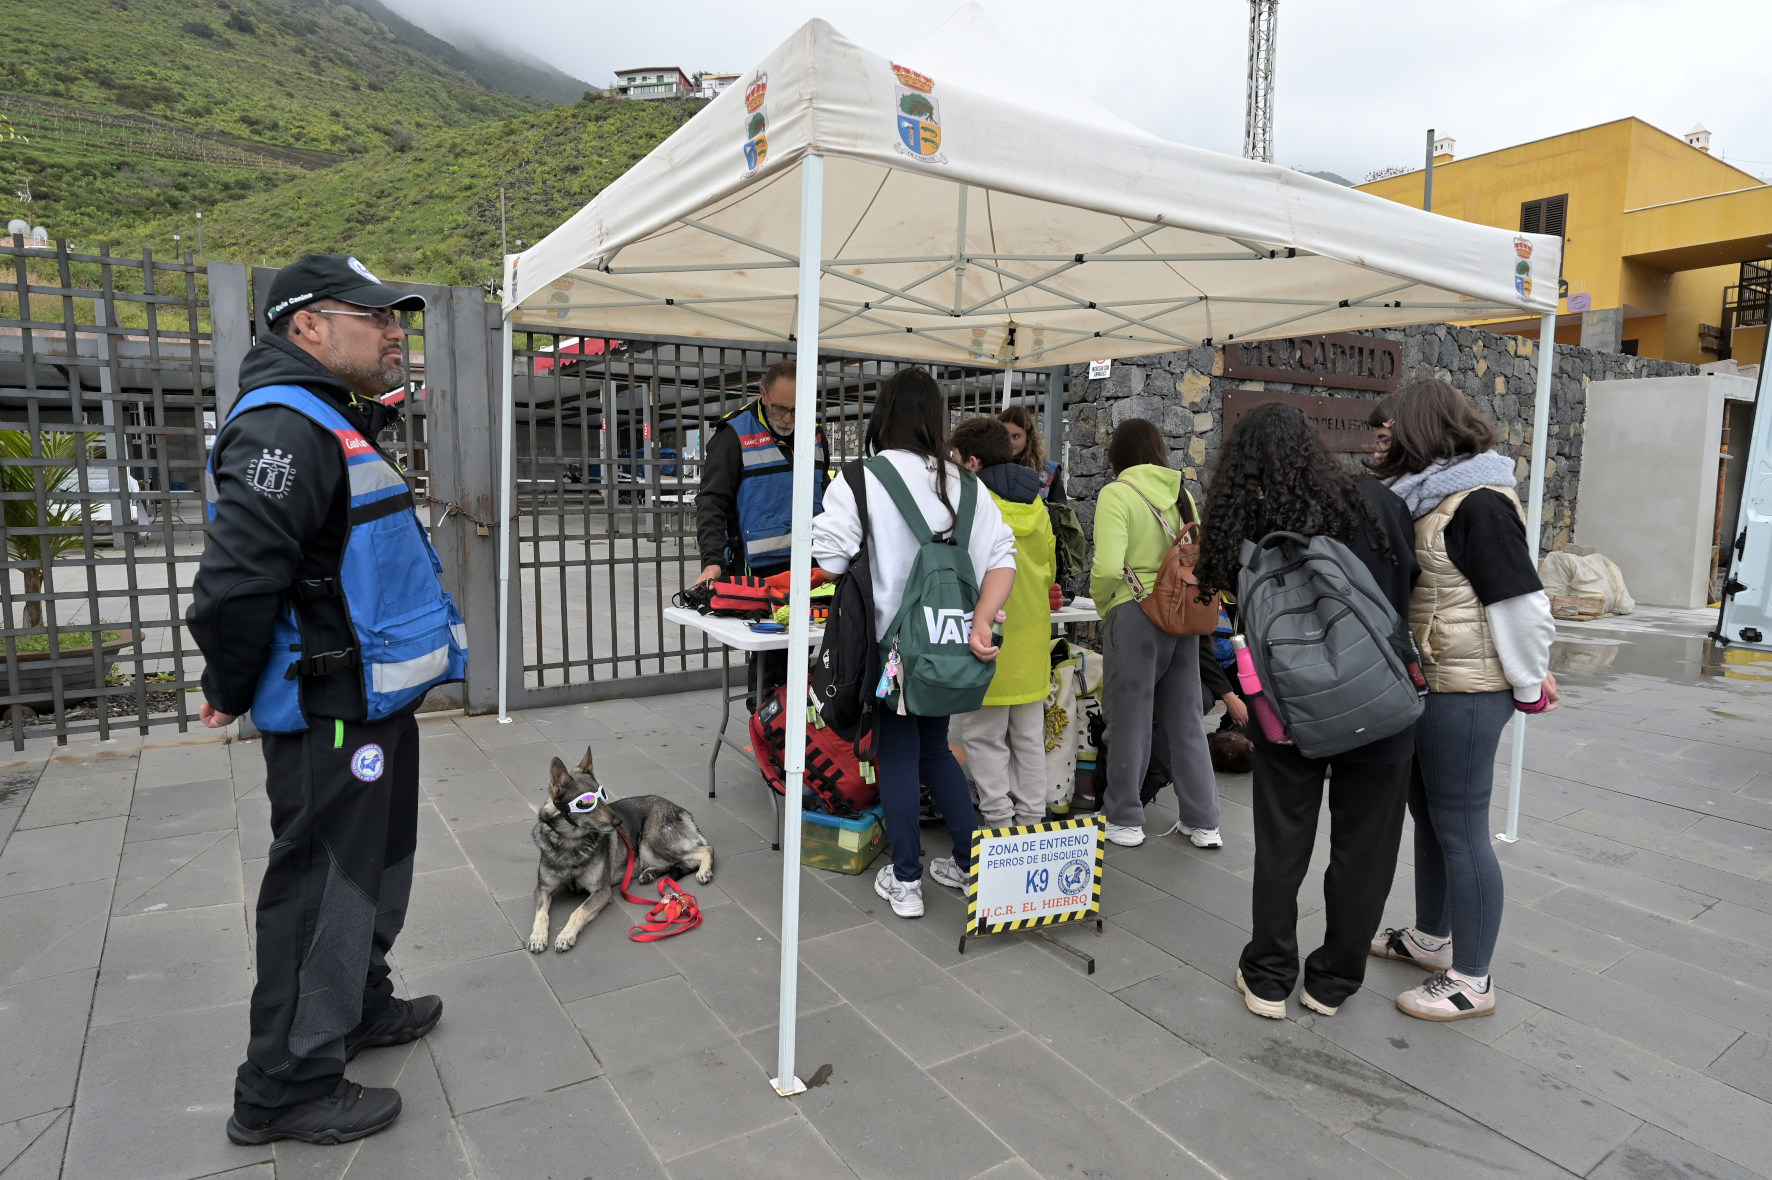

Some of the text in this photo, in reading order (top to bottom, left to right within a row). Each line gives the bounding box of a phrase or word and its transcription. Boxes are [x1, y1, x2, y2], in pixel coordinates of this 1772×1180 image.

[289, 292, 313, 304] Canino
[1239, 338, 1394, 379] MERCADILLO
[1335, 418, 1345, 430] LA
[277, 468, 297, 499] HIERRO
[988, 834, 1089, 857] ZONA DE ENTRENO
[988, 848, 1089, 869] PERROS DE BÚSQUEDA
[1026, 868, 1048, 894] K9
[981, 894, 1088, 918] U.C.R. EL HIERRO
